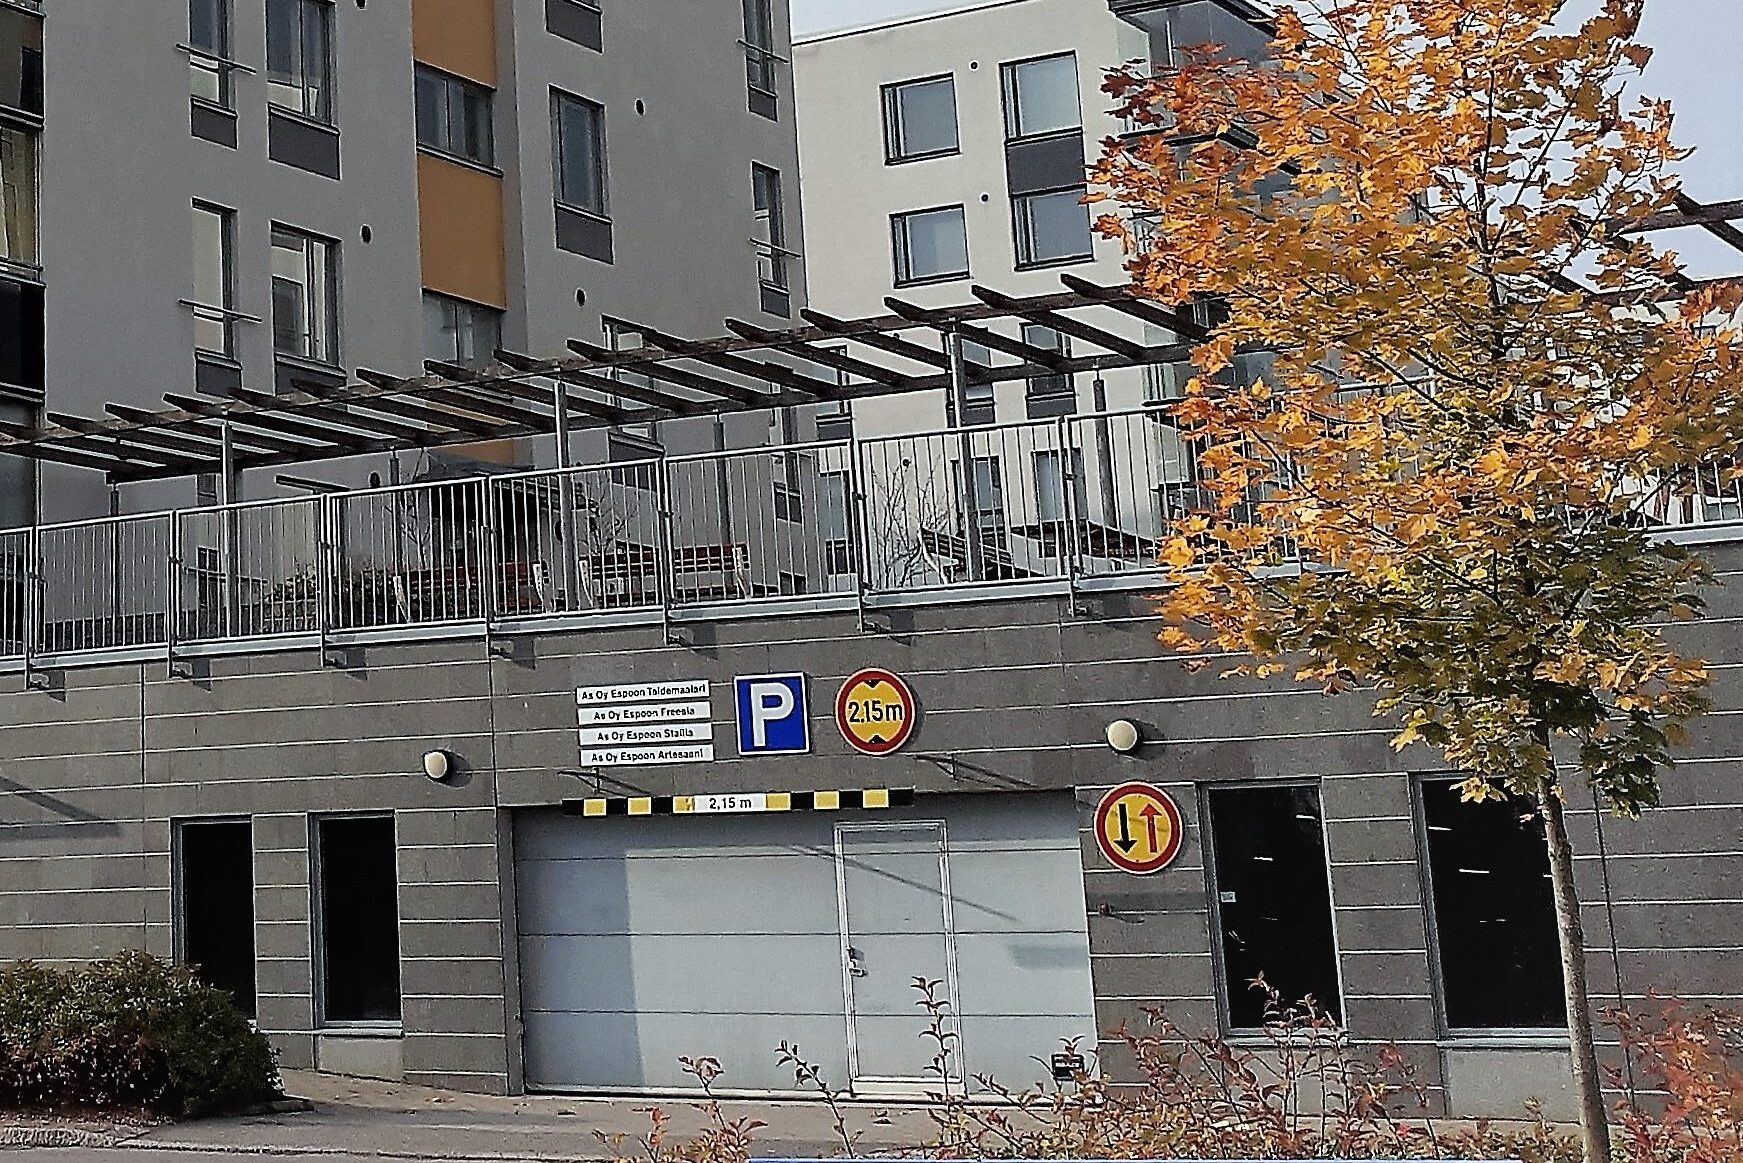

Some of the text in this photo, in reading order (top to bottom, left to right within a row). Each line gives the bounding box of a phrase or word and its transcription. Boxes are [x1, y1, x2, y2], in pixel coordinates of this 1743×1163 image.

[582, 691, 594, 700] As
[596, 690, 608, 700] Oy
[611, 688, 646, 699] Espoon
[593, 711, 606, 720] As
[608, 710, 620, 721] Oy
[623, 709, 659, 720] Espoon
[750, 682, 794, 747] P
[597, 732, 609, 741] As
[611, 731, 624, 742] Oy
[626, 730, 662, 741] Espoon
[591, 753, 604, 762] As
[606, 752, 618, 763] Oy
[620, 751, 656, 762] Espoon
[709, 797, 752, 811] 2,15 m
